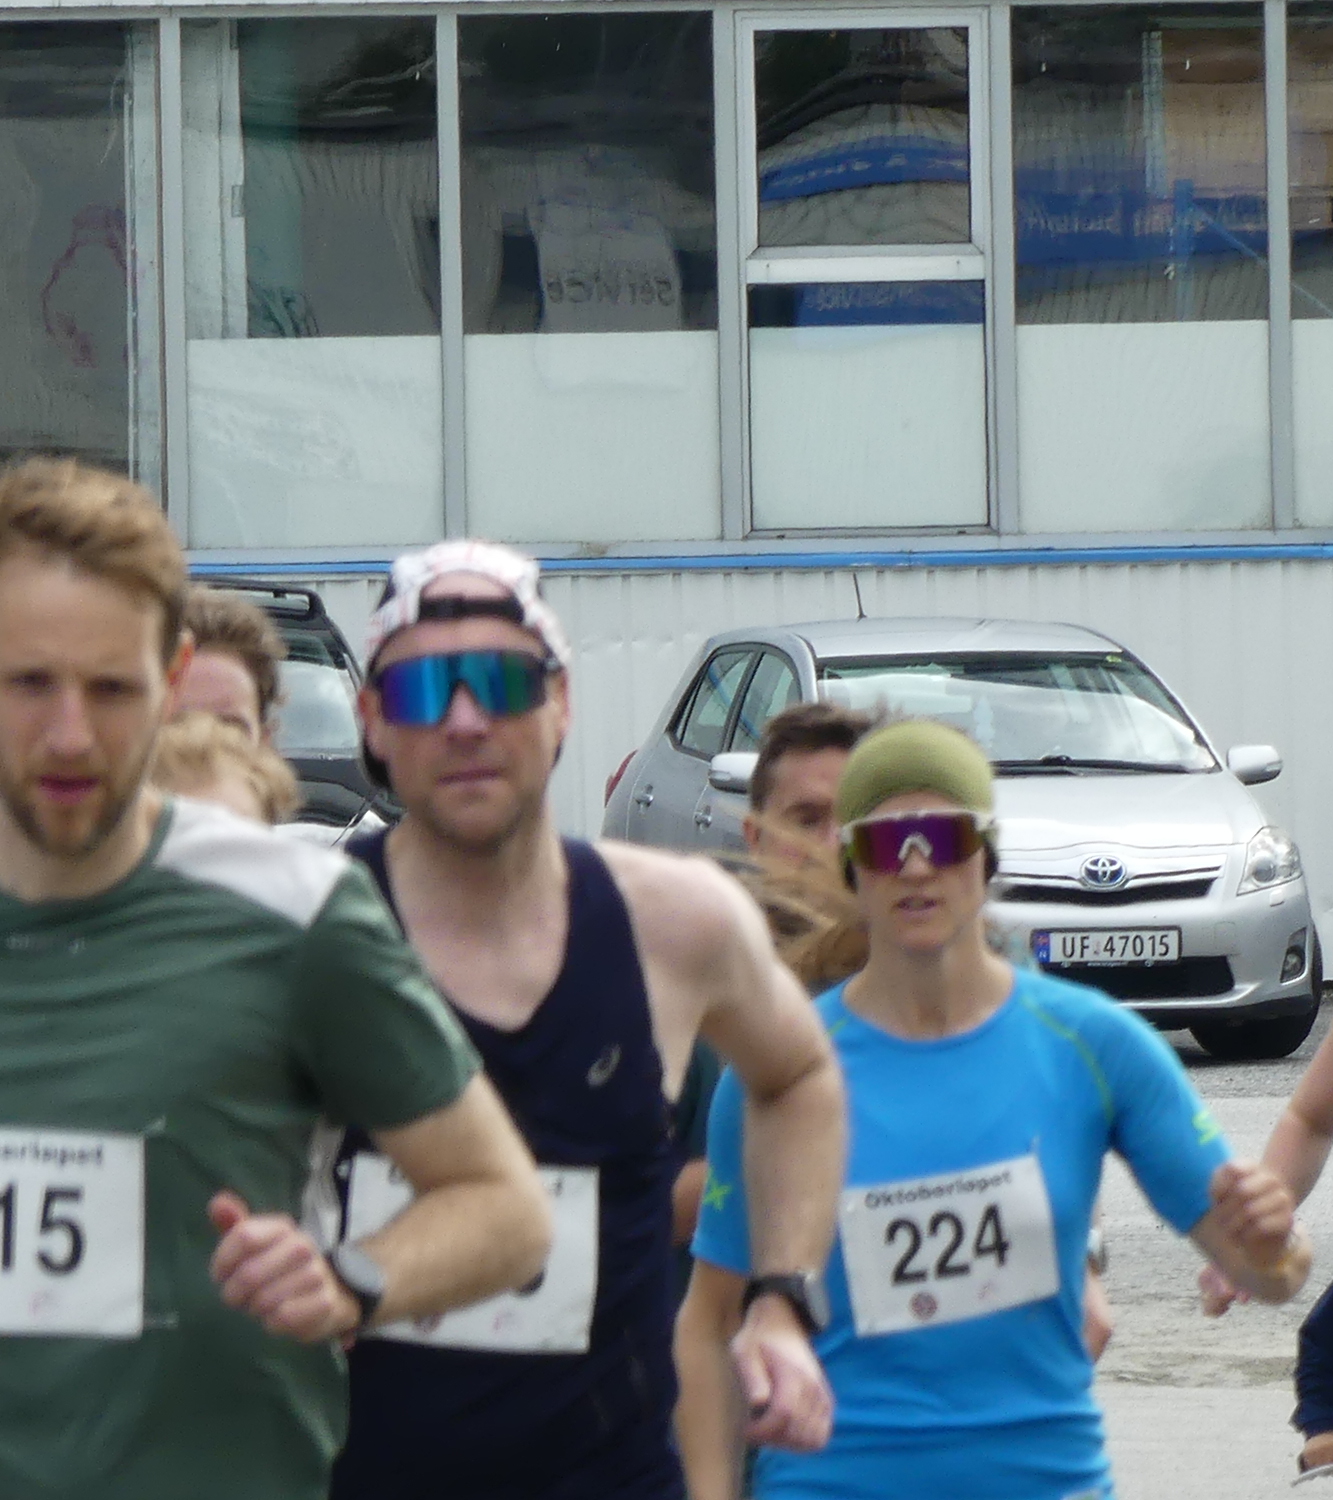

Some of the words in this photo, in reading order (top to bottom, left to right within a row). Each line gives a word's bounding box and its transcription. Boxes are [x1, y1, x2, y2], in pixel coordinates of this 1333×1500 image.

[1062, 936, 1090, 958] UF
[1103, 934, 1170, 957] 47015
[0, 1180, 86, 1276] 15
[885, 1203, 1011, 1287] 224
